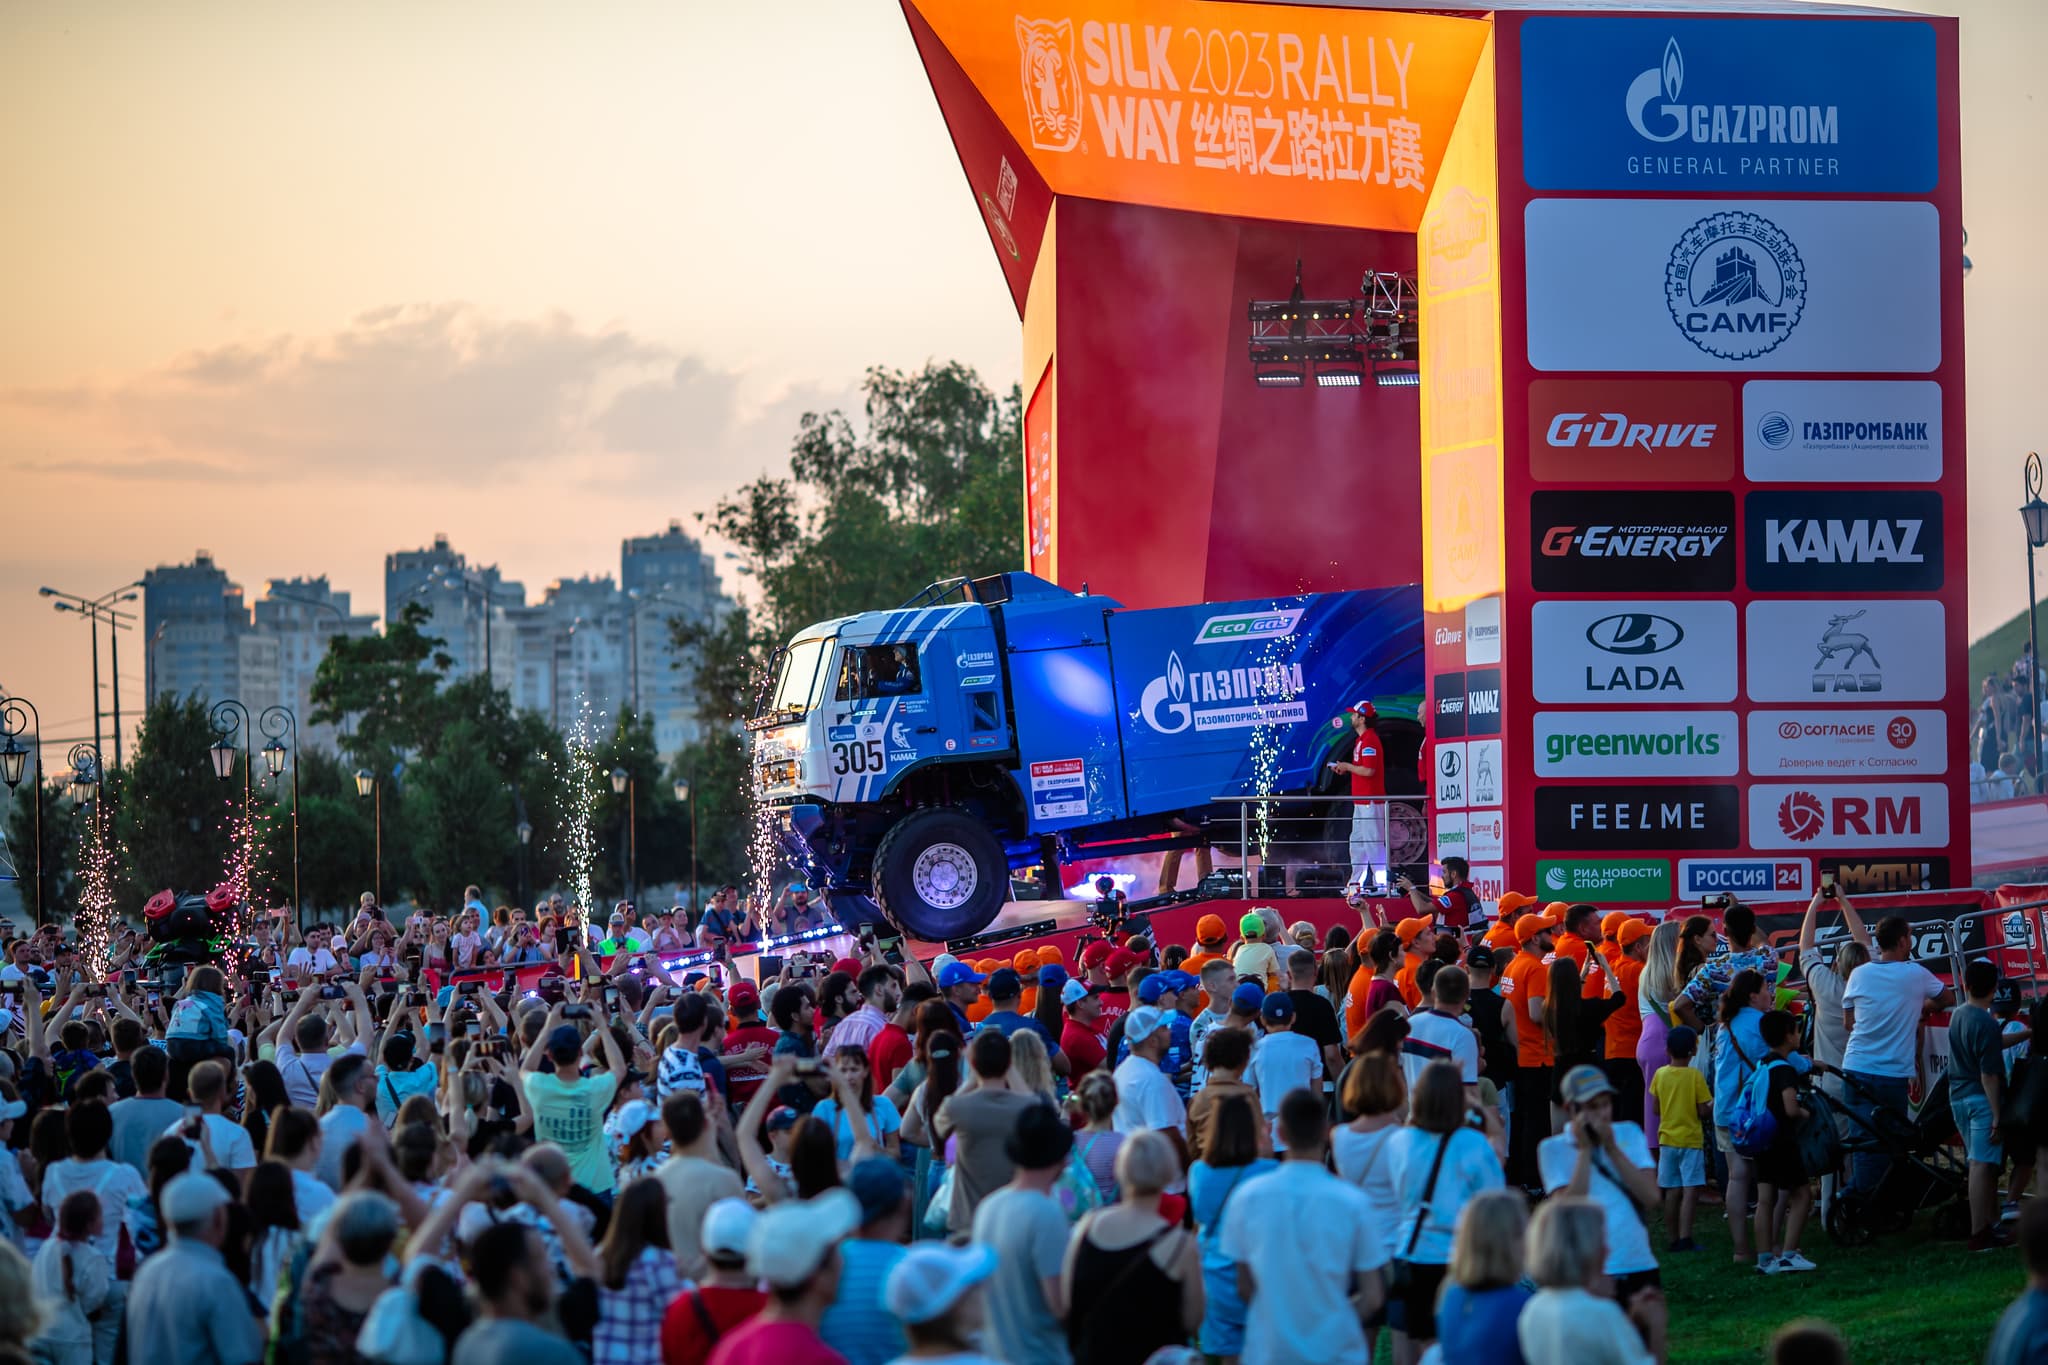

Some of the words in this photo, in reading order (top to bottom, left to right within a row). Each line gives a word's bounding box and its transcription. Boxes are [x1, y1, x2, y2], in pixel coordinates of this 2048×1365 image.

[1082, 20, 1181, 91] SILK
[1184, 27, 1275, 99] 2023
[1277, 33, 1415, 110] RALLY
[1090, 93, 1183, 164] WAY
[1691, 105, 1839, 144] GAZPROM
[1190, 102, 1424, 193] 丝绸之路拉力赛
[1627, 156, 1728, 175] GENERAL
[1740, 157, 1840, 177] PARTNER
[1673, 220, 1799, 301] 中国汽车摩托车运动联合会
[1685, 312, 1788, 334] CAMF
[1803, 421, 1929, 441] ГАЗПРОМБАНК
[1617, 525, 1685, 534] МОТОРНОЕ
[1686, 525, 1728, 534] МАСЛО
[1765, 519, 1925, 564] KAMAZ
[1189, 663, 1305, 702] ГАЗПРОМ
[1586, 666, 1685, 691] LADA
[1812, 674, 1882, 693] ГАЗ
[1469, 690, 1499, 715] KAMAZ
[1197, 711, 1263, 726] ГАЗОМОТОРНОЕ
[1265, 708, 1304, 719] ТОПЛИВО
[1804, 724, 1876, 736] СОГЛАСИЕ
[1891, 723, 1912, 738] 30
[1546, 726, 1720, 763] greenworks
[832, 740, 884, 775] 305
[890, 752, 917, 761] KAMAZ
[1778, 757, 1824, 768] Доверие
[1867, 757, 1918, 768] Согласию
[1441, 784, 1462, 801] LADA
[1832, 796, 1922, 835] RM
[1573, 868, 1600, 879] РИА
[1602, 868, 1662, 879] НОВОСТИ
[1573, 878, 1615, 889] СПОРТ
[1695, 869, 1767, 886] РОССИЯ
[1778, 869, 1800, 885] 24
[1482, 879, 1501, 901] RM
